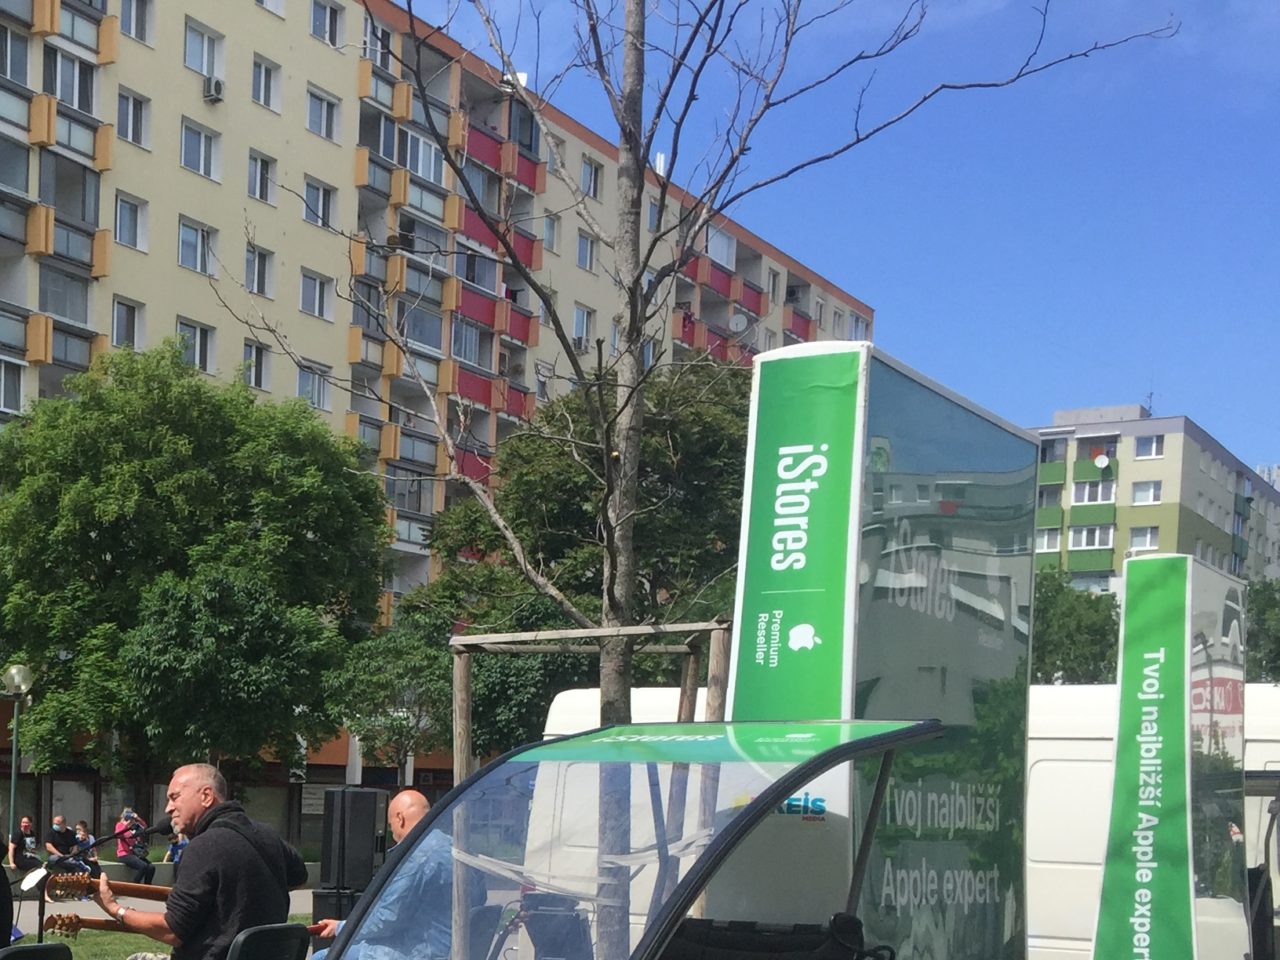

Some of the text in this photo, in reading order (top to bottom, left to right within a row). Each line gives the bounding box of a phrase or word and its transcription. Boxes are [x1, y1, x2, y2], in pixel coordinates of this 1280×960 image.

[769, 443, 829, 571] iStores
[886, 516, 960, 622] iStores
[755, 613, 769, 666] Reseller
[768, 609, 784, 668] Premium
[1142, 647, 1166, 702] Tvoj
[1135, 705, 1163, 810] najbližší
[884, 776, 1002, 840] Tvoj najbližší
[1131, 812, 1160, 884] Apple
[880, 857, 1001, 918] Apple expert
